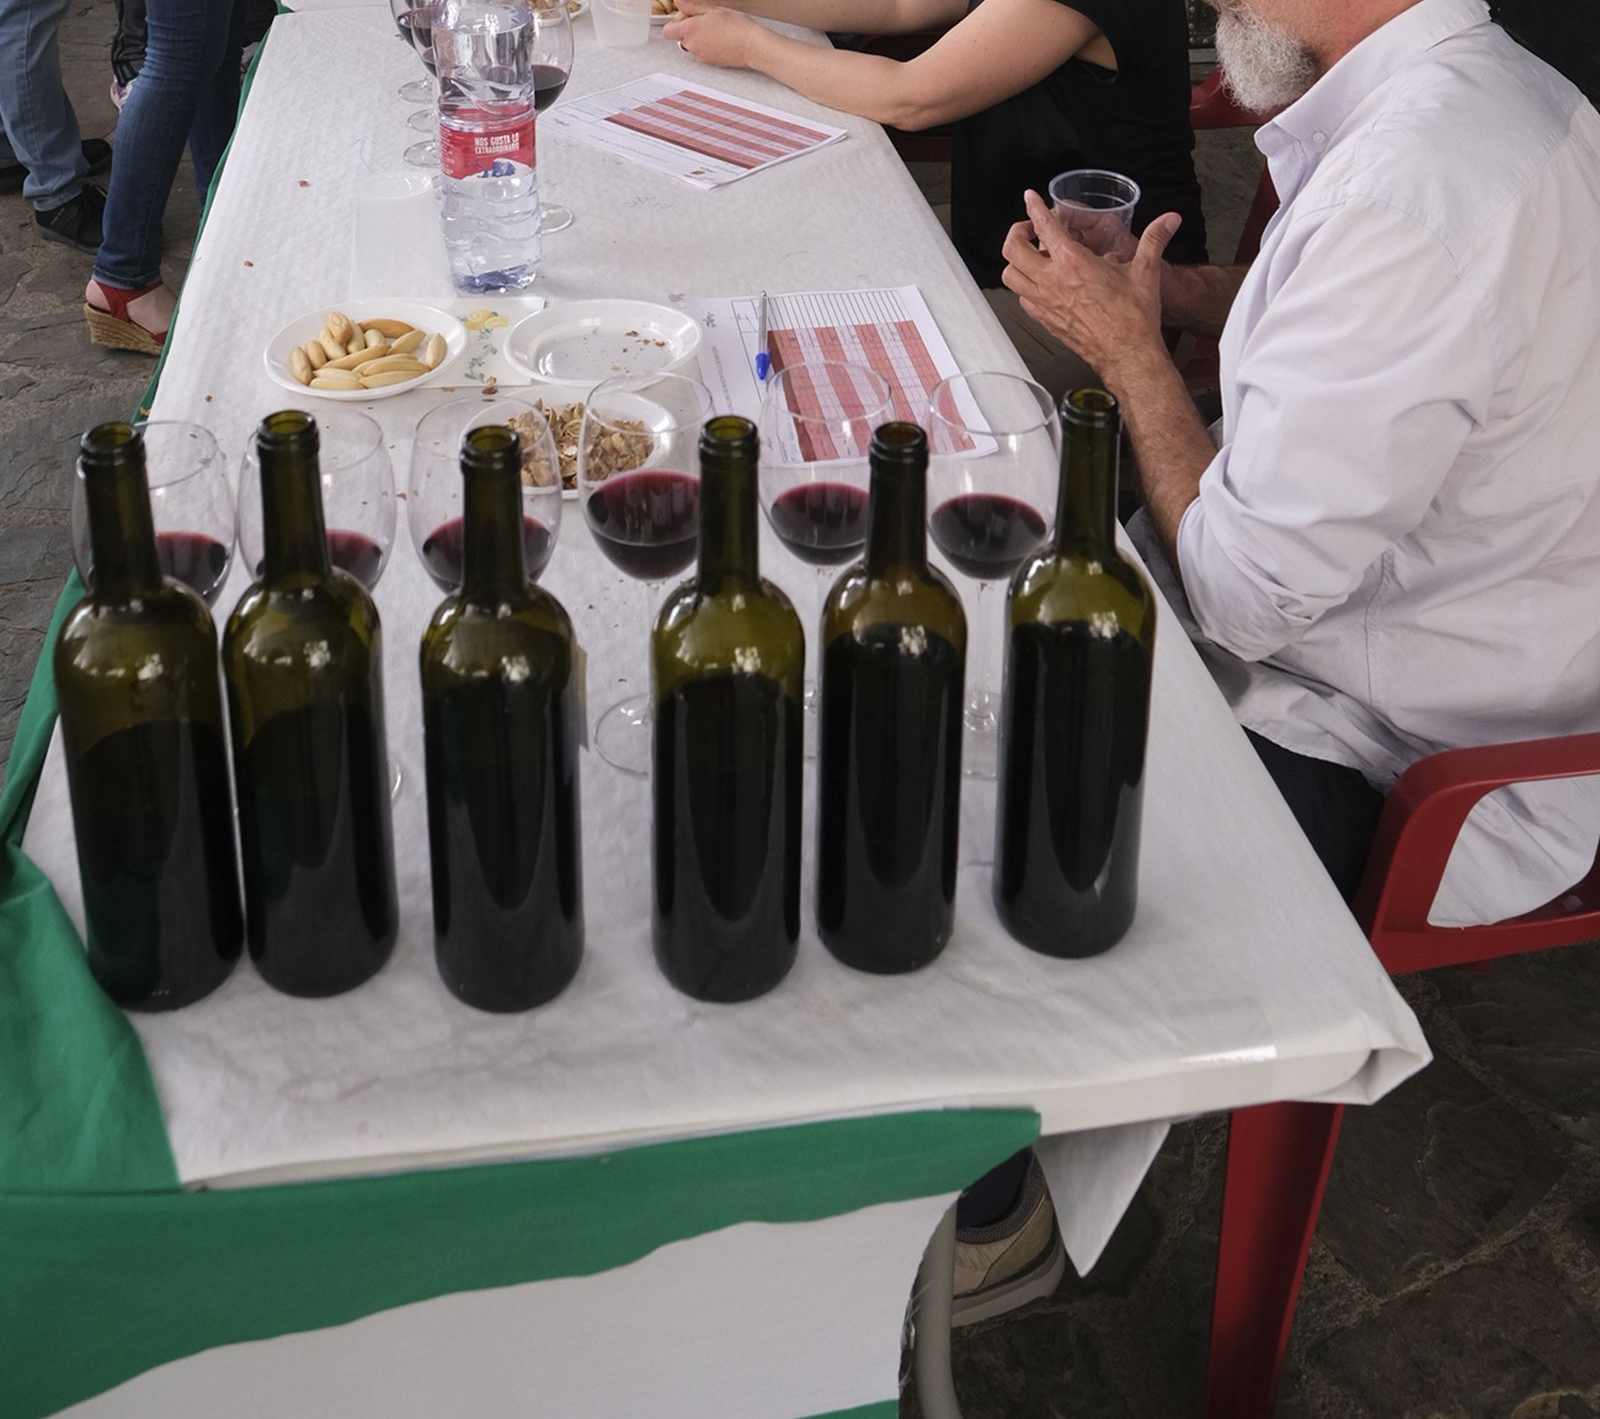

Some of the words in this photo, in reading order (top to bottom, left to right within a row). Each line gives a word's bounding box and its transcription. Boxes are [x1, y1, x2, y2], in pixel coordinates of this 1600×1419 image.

[474, 137, 489, 146] NOS
[490, 134, 510, 146] GUSTA
[511, 132, 519, 142] LO
